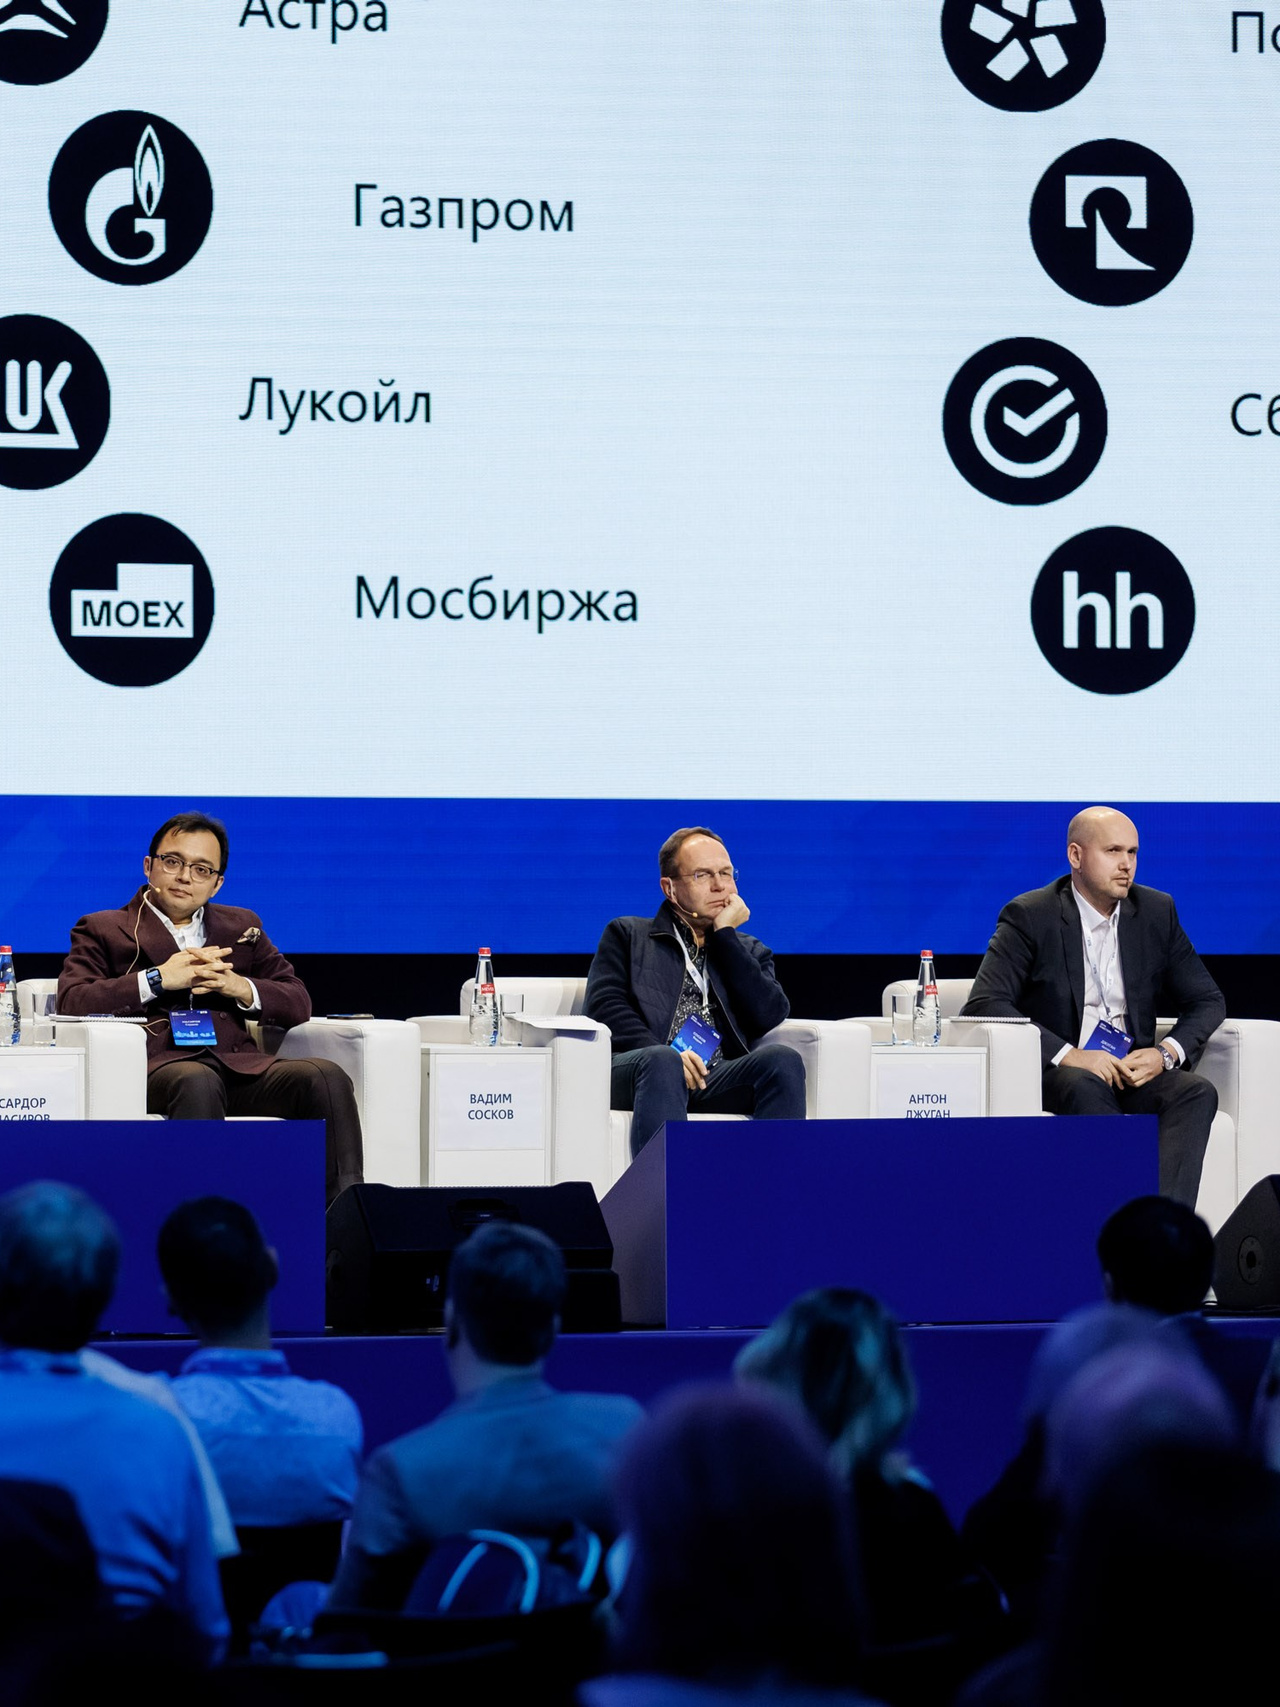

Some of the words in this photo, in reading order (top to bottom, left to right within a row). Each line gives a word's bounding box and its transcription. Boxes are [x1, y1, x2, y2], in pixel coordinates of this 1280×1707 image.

[238, 0, 388, 45] Астра
[354, 182, 574, 243] Газпром
[238, 377, 432, 436] Лукойл
[81, 600, 185, 628] MOEX
[355, 574, 639, 635] Мосбиржа
[1062, 570, 1164, 650] hh
[467, 1108, 515, 1121] СОСКОВ
[469, 1093, 513, 1106] ВАДИМ
[908, 1093, 948, 1105] АНТОН
